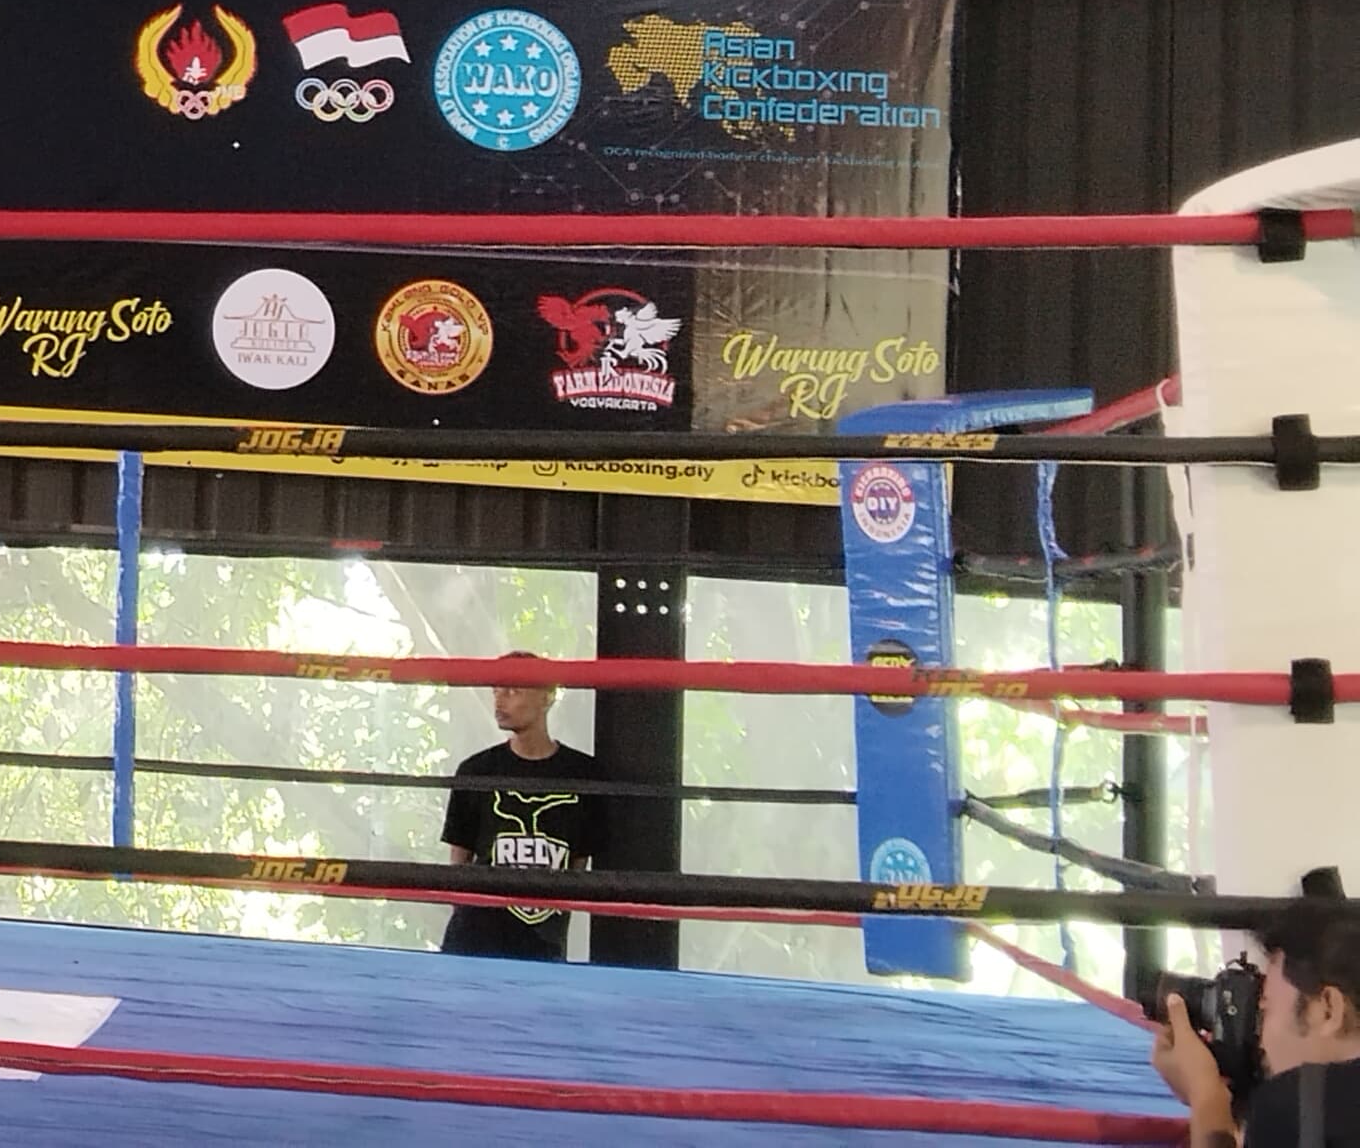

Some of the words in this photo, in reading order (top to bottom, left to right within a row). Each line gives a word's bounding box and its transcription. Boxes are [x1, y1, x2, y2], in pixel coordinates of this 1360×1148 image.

[434, 20, 479, 96] ASSOCIATION
[477, 13, 494, 29] OF
[702, 29, 796, 60] Asian
[461, 63, 559, 98] WAKO
[702, 61, 890, 100] Kickboxing
[701, 94, 942, 129] Confederation
[107, 297, 173, 342] Soto
[237, 352, 272, 365] IWAK
[276, 354, 308, 367] KALI
[722, 332, 869, 382] Warung
[870, 334, 940, 383] Soto
[552, 370, 596, 400] FARM
[570, 397, 659, 412] YOGYAKARTA
[238, 429, 346, 453] JOGJA
[770, 469, 840, 489] kickbo
[866, 496, 898, 511] DIY
[496, 837, 567, 870] REDY
[242, 861, 348, 884] JOGJA
